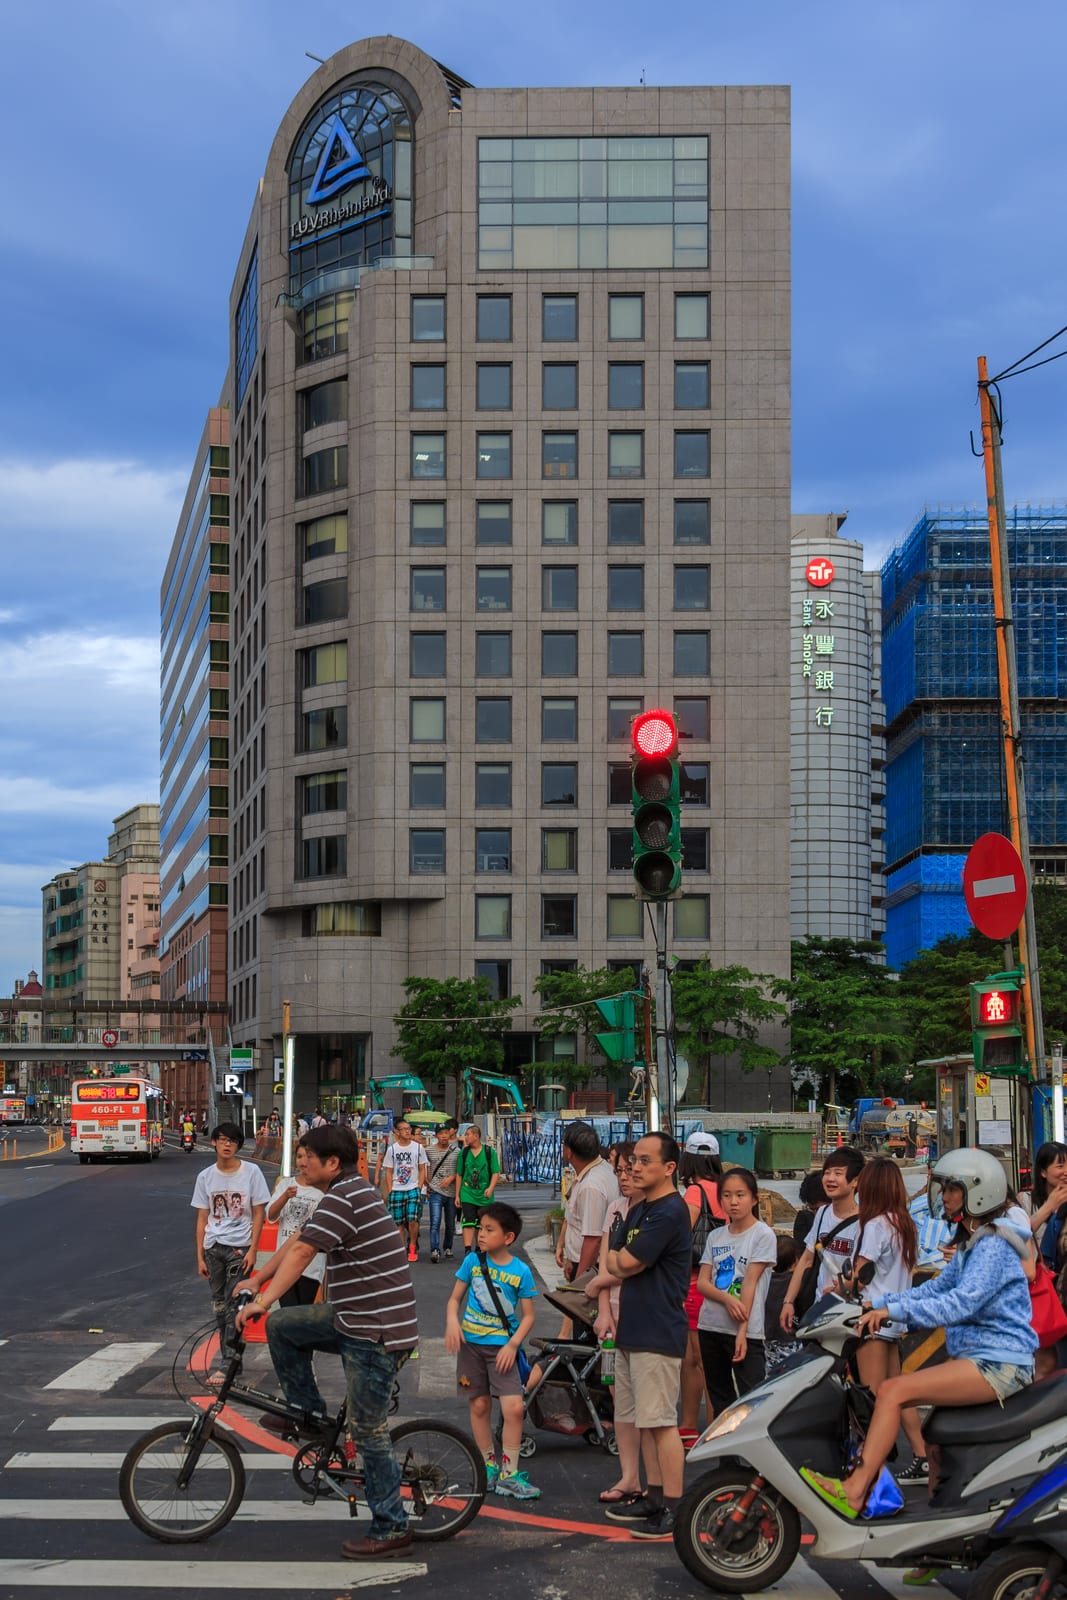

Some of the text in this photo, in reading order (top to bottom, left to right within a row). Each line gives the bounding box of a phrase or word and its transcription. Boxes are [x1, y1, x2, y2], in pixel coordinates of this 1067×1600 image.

[803, 599, 813, 677] Bank SinoPac
[815, 599, 834, 726] 永豐銀行
[224, 1074, 240, 1092] P
[101, 1087, 116, 1099] 518
[91, 1105, 125, 1114] 460-FL
[395, 1152, 412, 1161] ROCK
